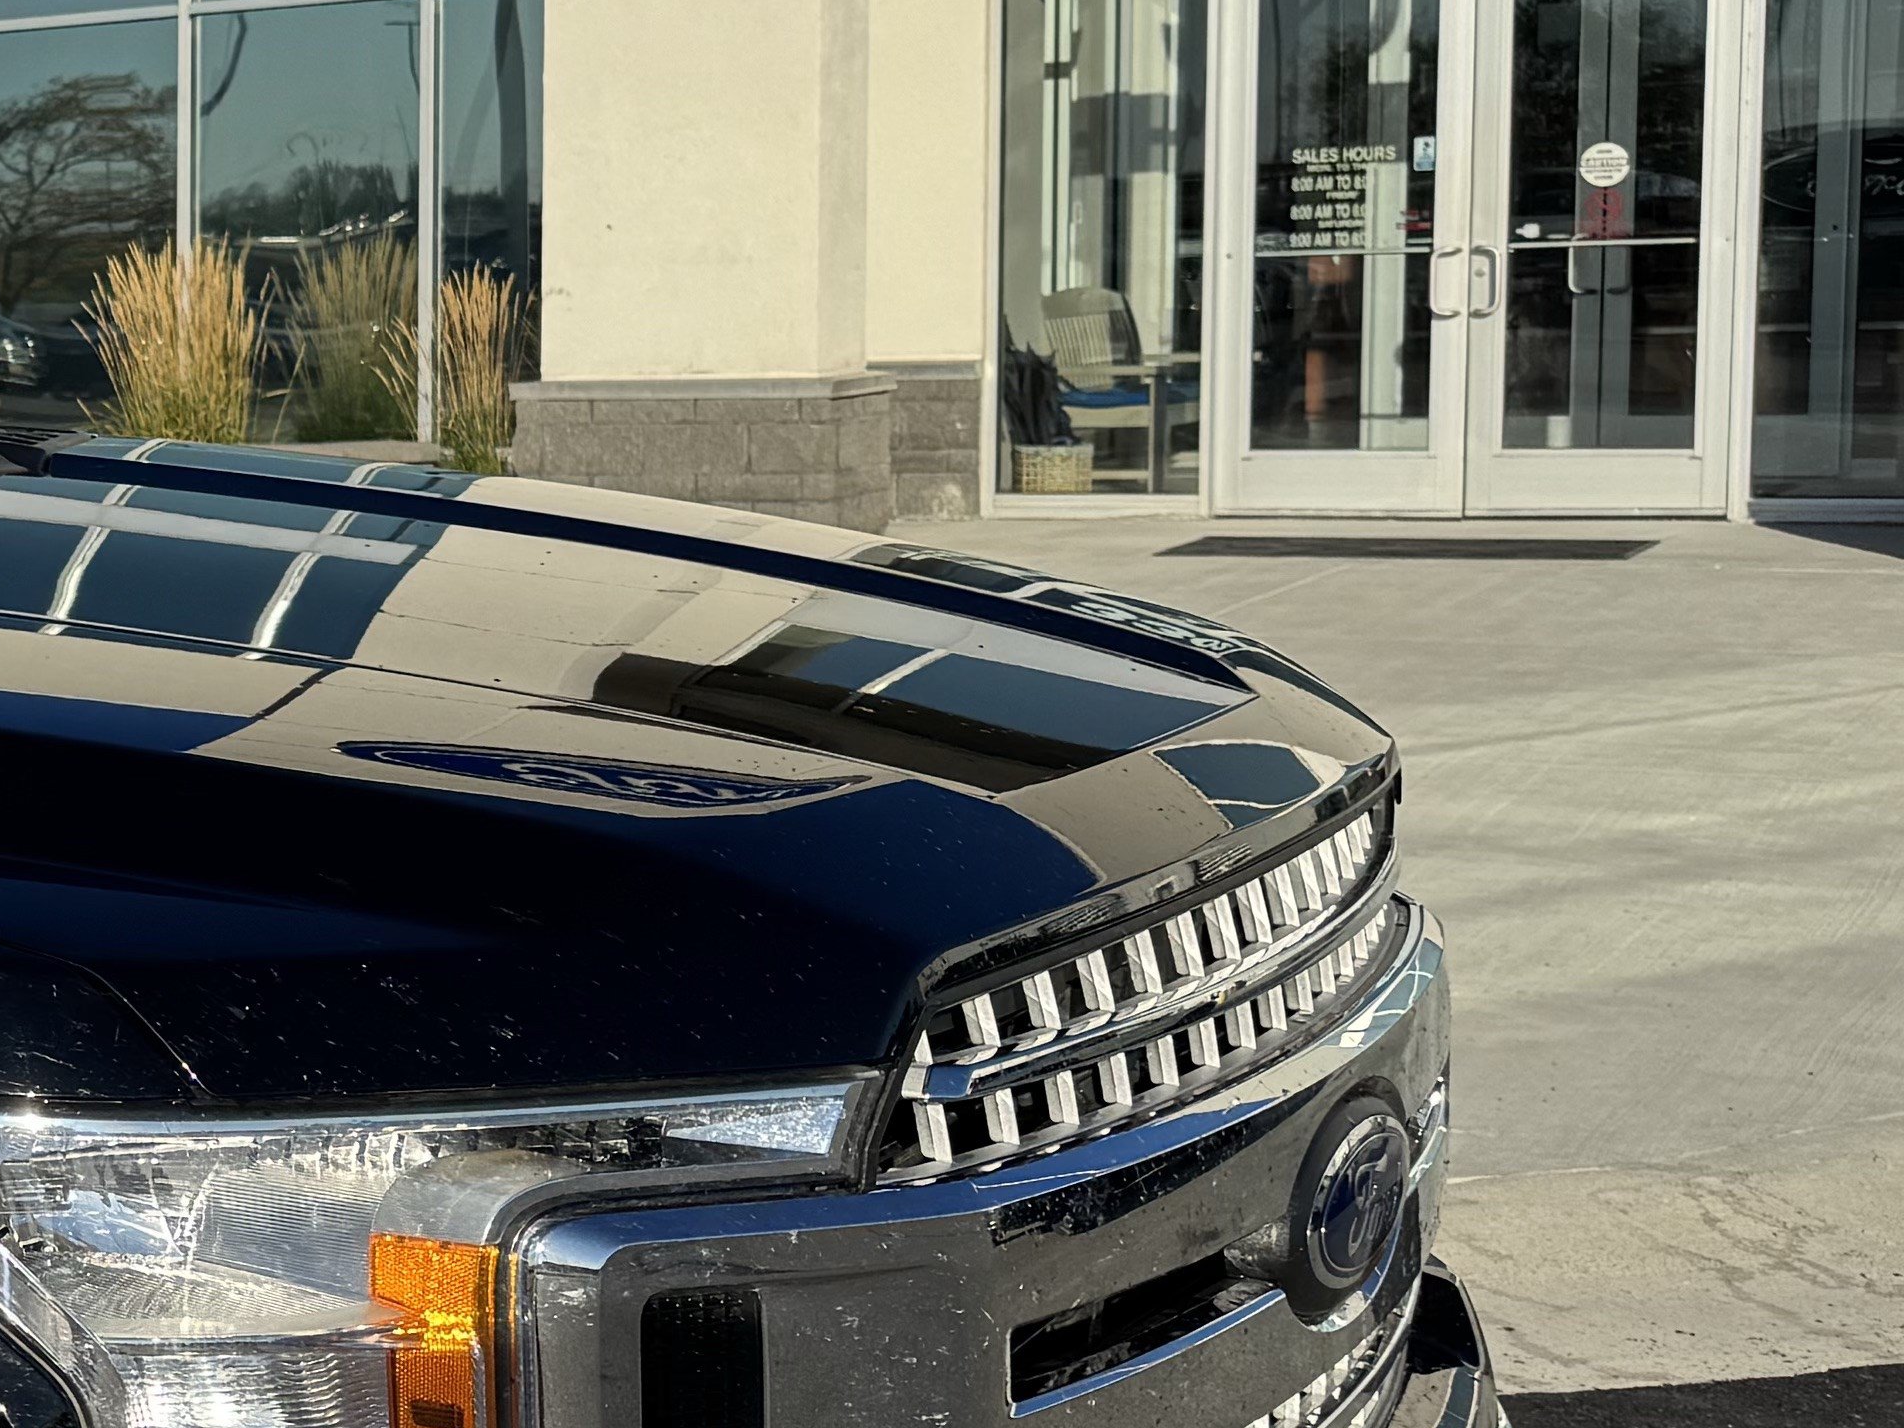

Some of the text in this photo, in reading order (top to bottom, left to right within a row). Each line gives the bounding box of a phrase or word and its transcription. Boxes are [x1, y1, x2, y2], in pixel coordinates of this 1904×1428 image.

[1292, 147, 1339, 164] SALES
[1342, 145, 1396, 163] HOURS
[1315, 175, 1333, 191] AM
[1336, 174, 1351, 190] TO
[1314, 203, 1332, 220] AM
[1335, 203, 1350, 219] TO
[1314, 232, 1332, 247] AM
[1335, 232, 1350, 247] TO
